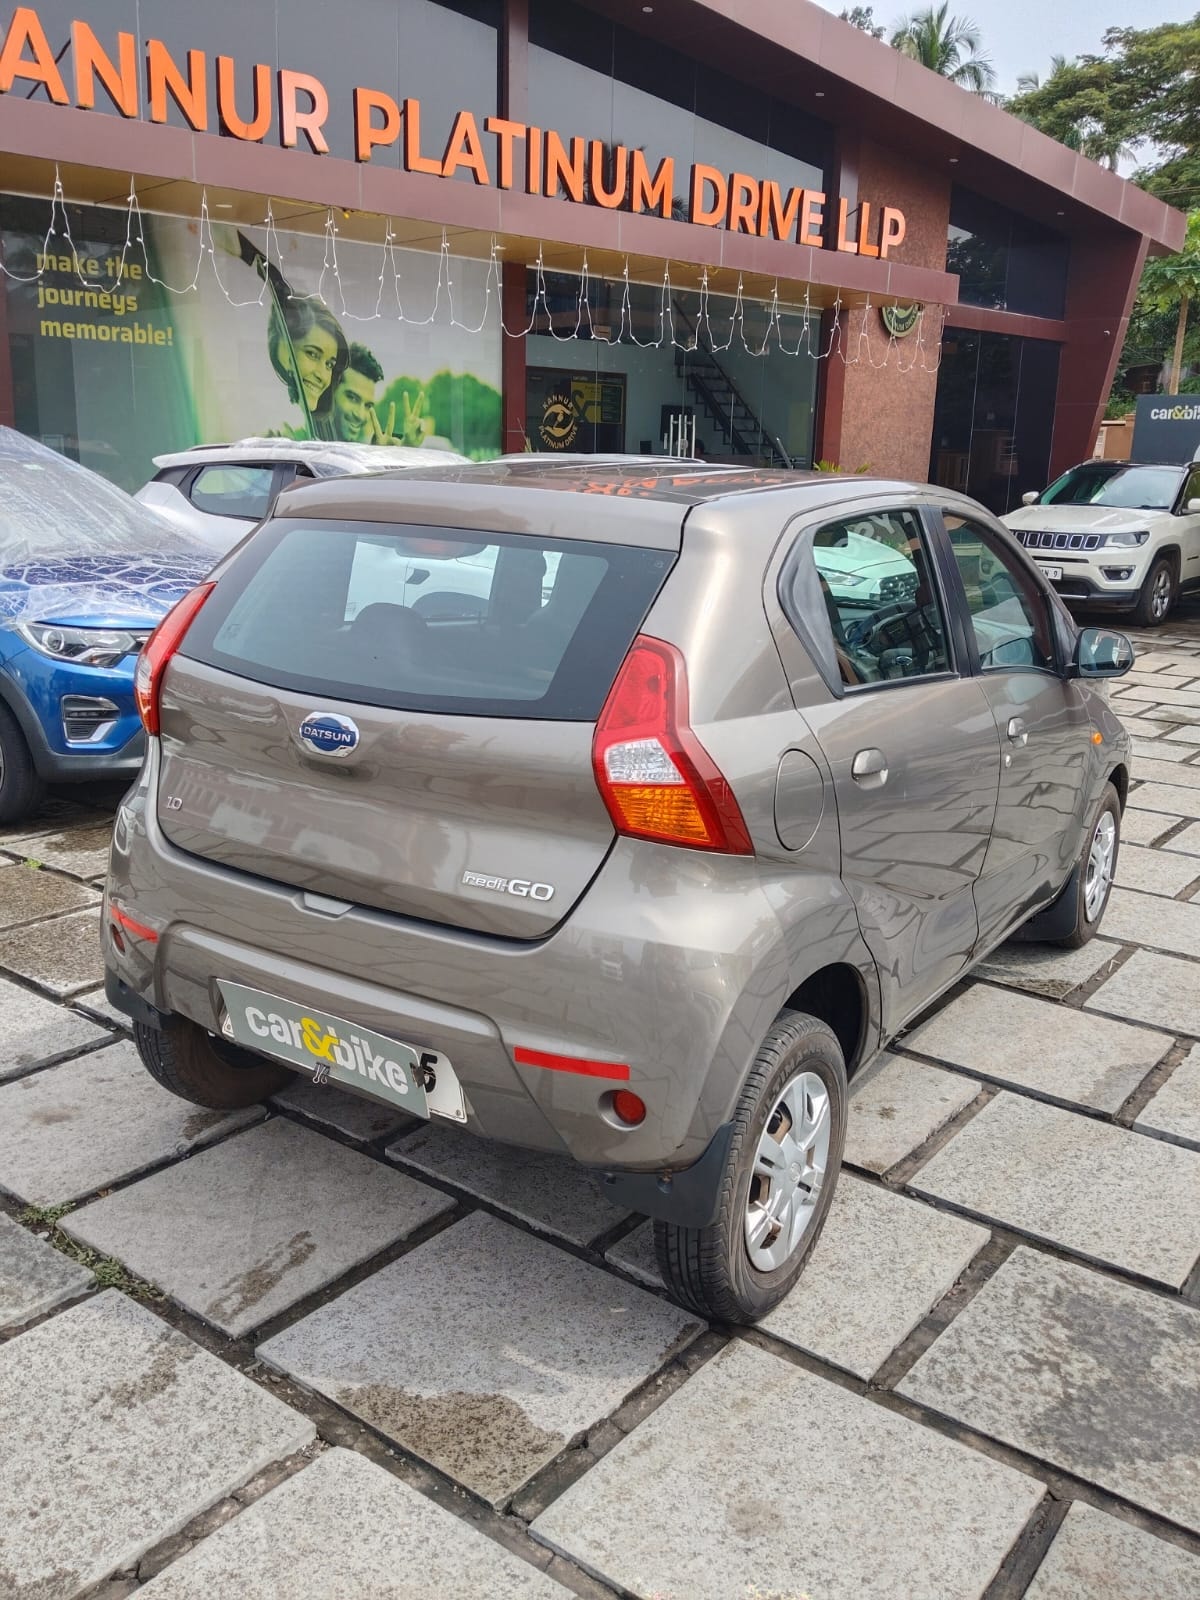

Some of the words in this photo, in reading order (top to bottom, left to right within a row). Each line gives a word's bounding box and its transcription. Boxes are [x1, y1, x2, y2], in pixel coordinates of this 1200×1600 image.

[0, 7, 330, 155] ANNUR
[353, 87, 675, 218] PLATINUM
[690, 162, 826, 248] DRIVE
[836, 197, 907, 258] LLP
[36, 251, 100, 275] make
[105, 255, 143, 280] the
[37, 281, 138, 316] journeys
[40, 319, 174, 346] memorable!
[303, 726, 351, 743] DATSUN
[245, 1006, 409, 1095] car&bike
